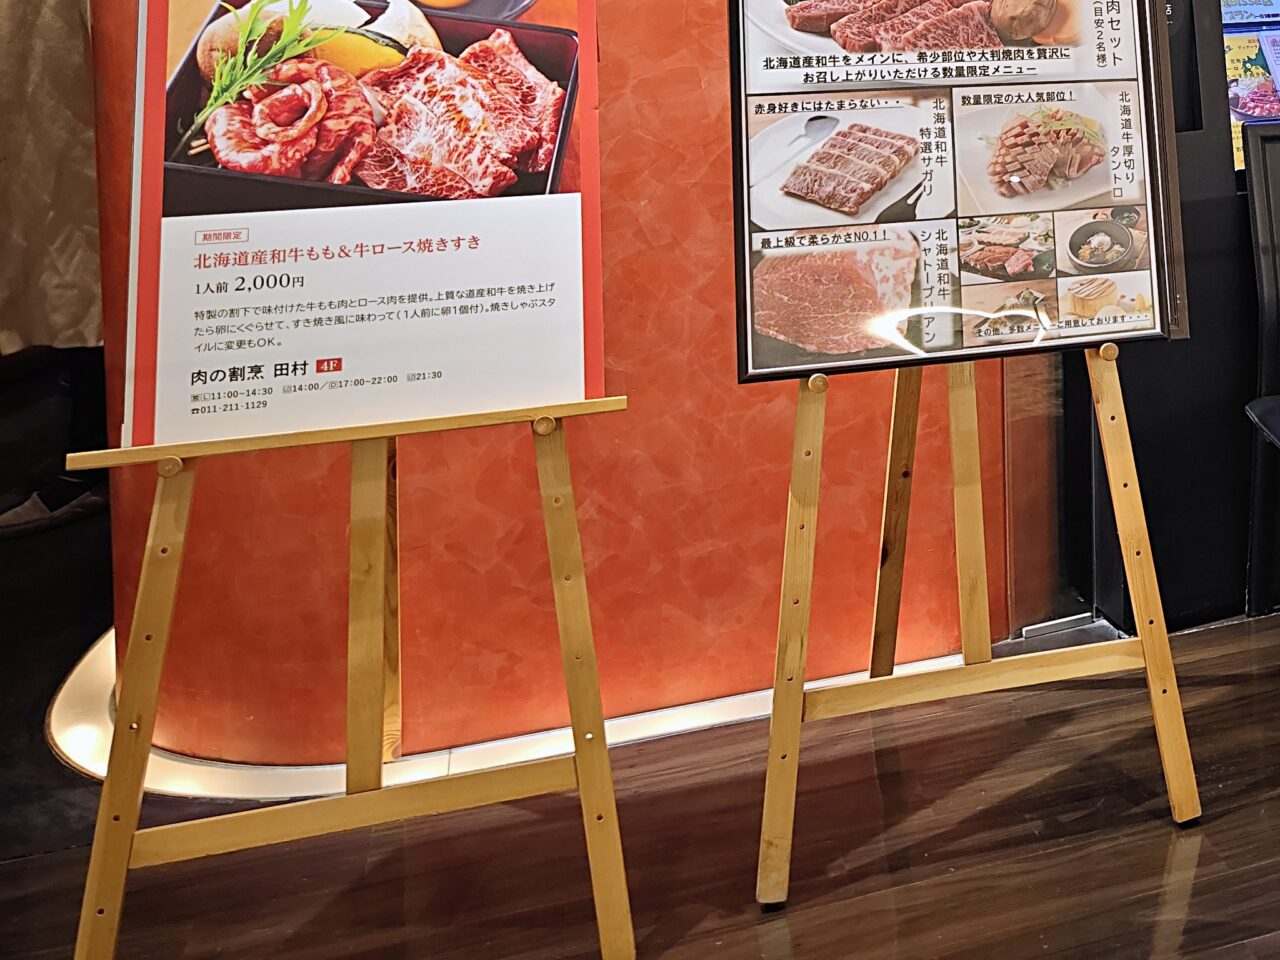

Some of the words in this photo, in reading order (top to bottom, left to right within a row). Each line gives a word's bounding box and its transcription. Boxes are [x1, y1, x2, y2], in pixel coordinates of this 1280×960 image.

[762, 47, 1070, 70] 北海道産和牛をメインに、希少部位や大判焼肉を贅沢に
[802, 66, 1037, 84] お召し上がりいただける数量限定メニュー
[932, 98, 948, 168] 北海道和牛
[1119, 91, 1135, 184] 北海道牛厚切り
[919, 127, 934, 196] 特選サガリ
[1110, 146, 1124, 198] タントロ
[202, 231, 242, 242] 期間限定
[196, 282, 228, 294] 1人前
[234, 272, 304, 293] 2,000円
[934, 228, 950, 300] 北海道和牛
[191, 365, 265, 386] 肉の割烹
[274, 360, 309, 378] 田村
[320, 360, 338, 372] 4F
